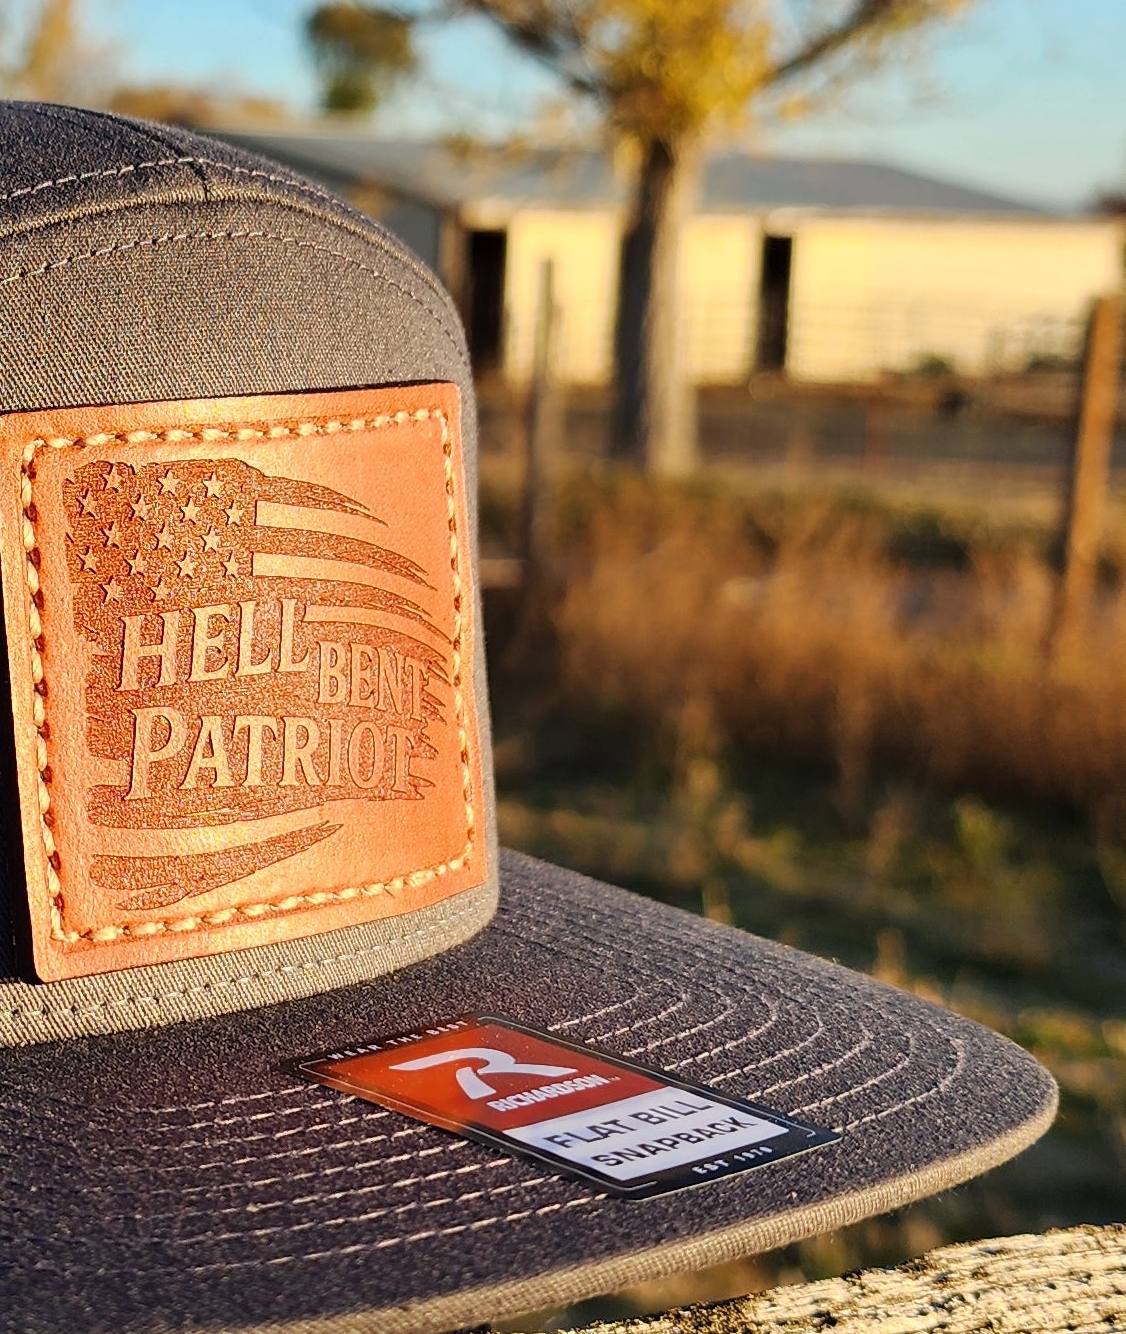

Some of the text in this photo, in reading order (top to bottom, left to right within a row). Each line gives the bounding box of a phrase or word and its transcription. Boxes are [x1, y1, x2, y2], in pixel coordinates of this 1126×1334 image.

[115, 598, 430, 722] HELL BENT
[123, 706, 419, 801] PATRIOT
[327, 1020, 469, 1060] WEAR THE BEST
[486, 1074, 610, 1112] RICHARDSON
[543, 1100, 714, 1149] FLAT BILL
[590, 1116, 758, 1167] SNAPBACK
[691, 1159, 730, 1175] EST
